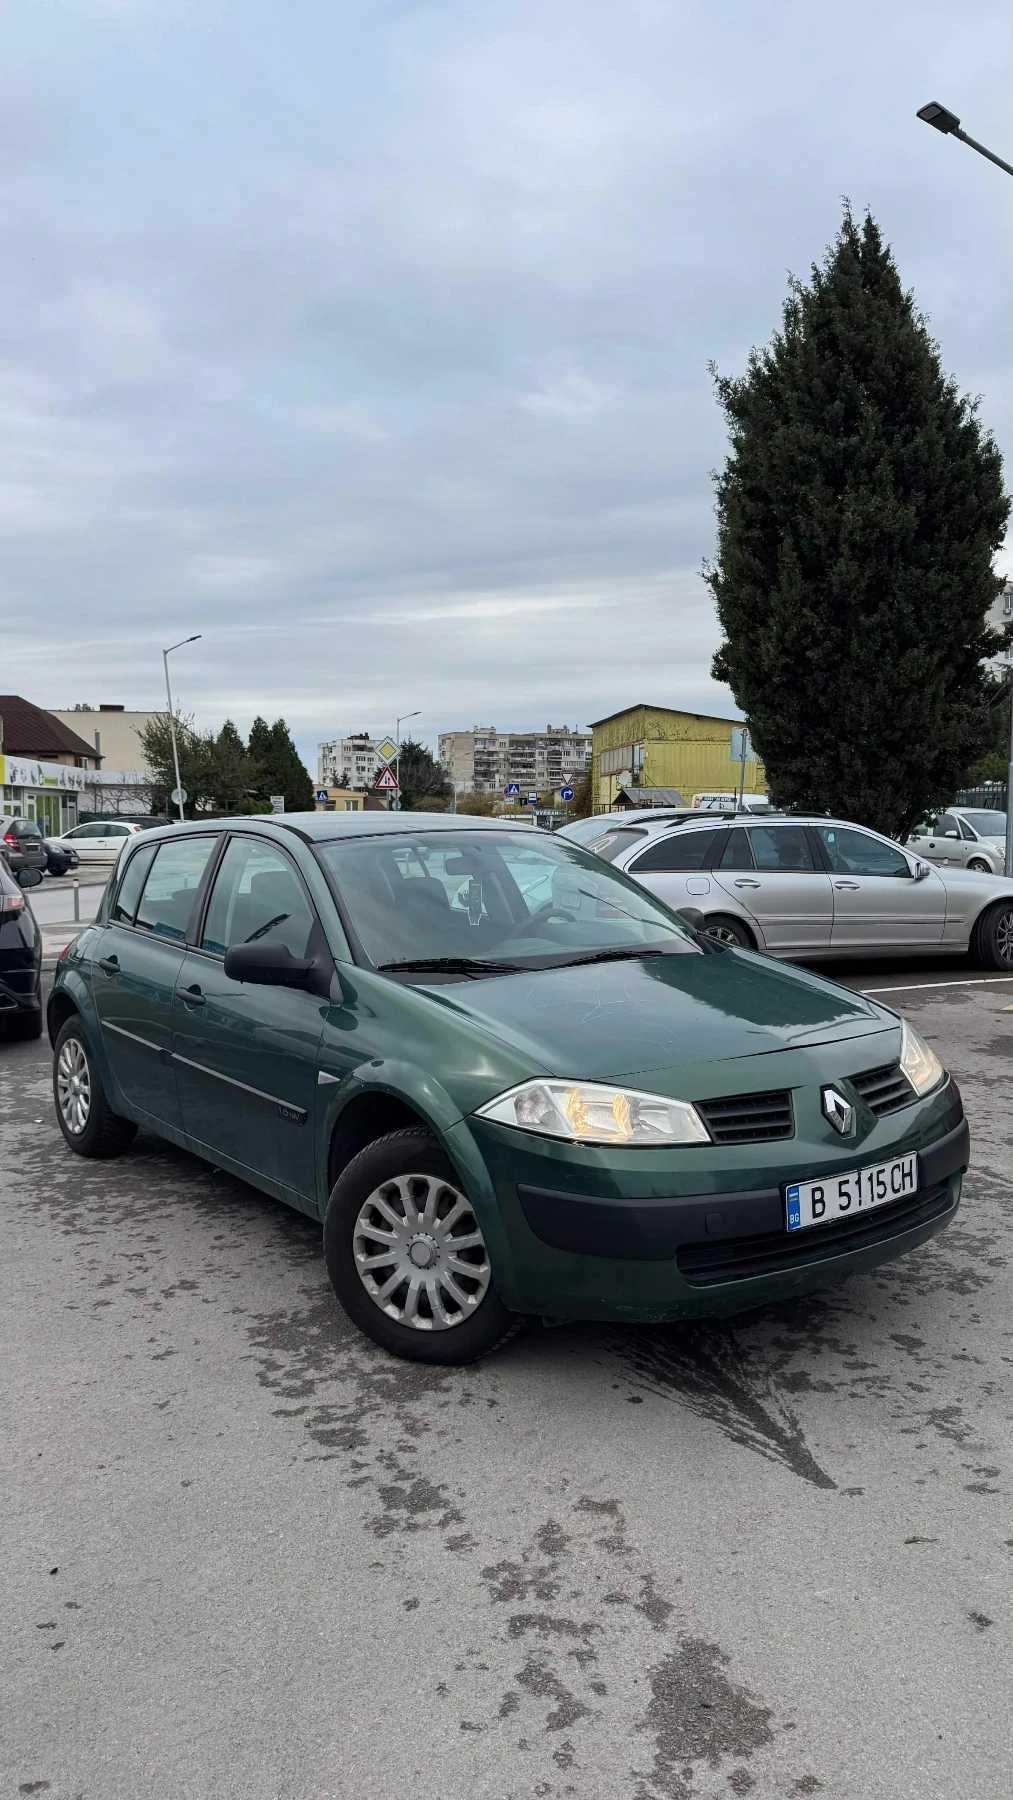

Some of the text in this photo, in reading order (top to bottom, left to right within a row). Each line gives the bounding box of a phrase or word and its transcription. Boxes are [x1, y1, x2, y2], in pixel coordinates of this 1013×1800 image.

[811, 1158, 914, 1219] B 5115 CH
[789, 1213, 800, 1225] BG
